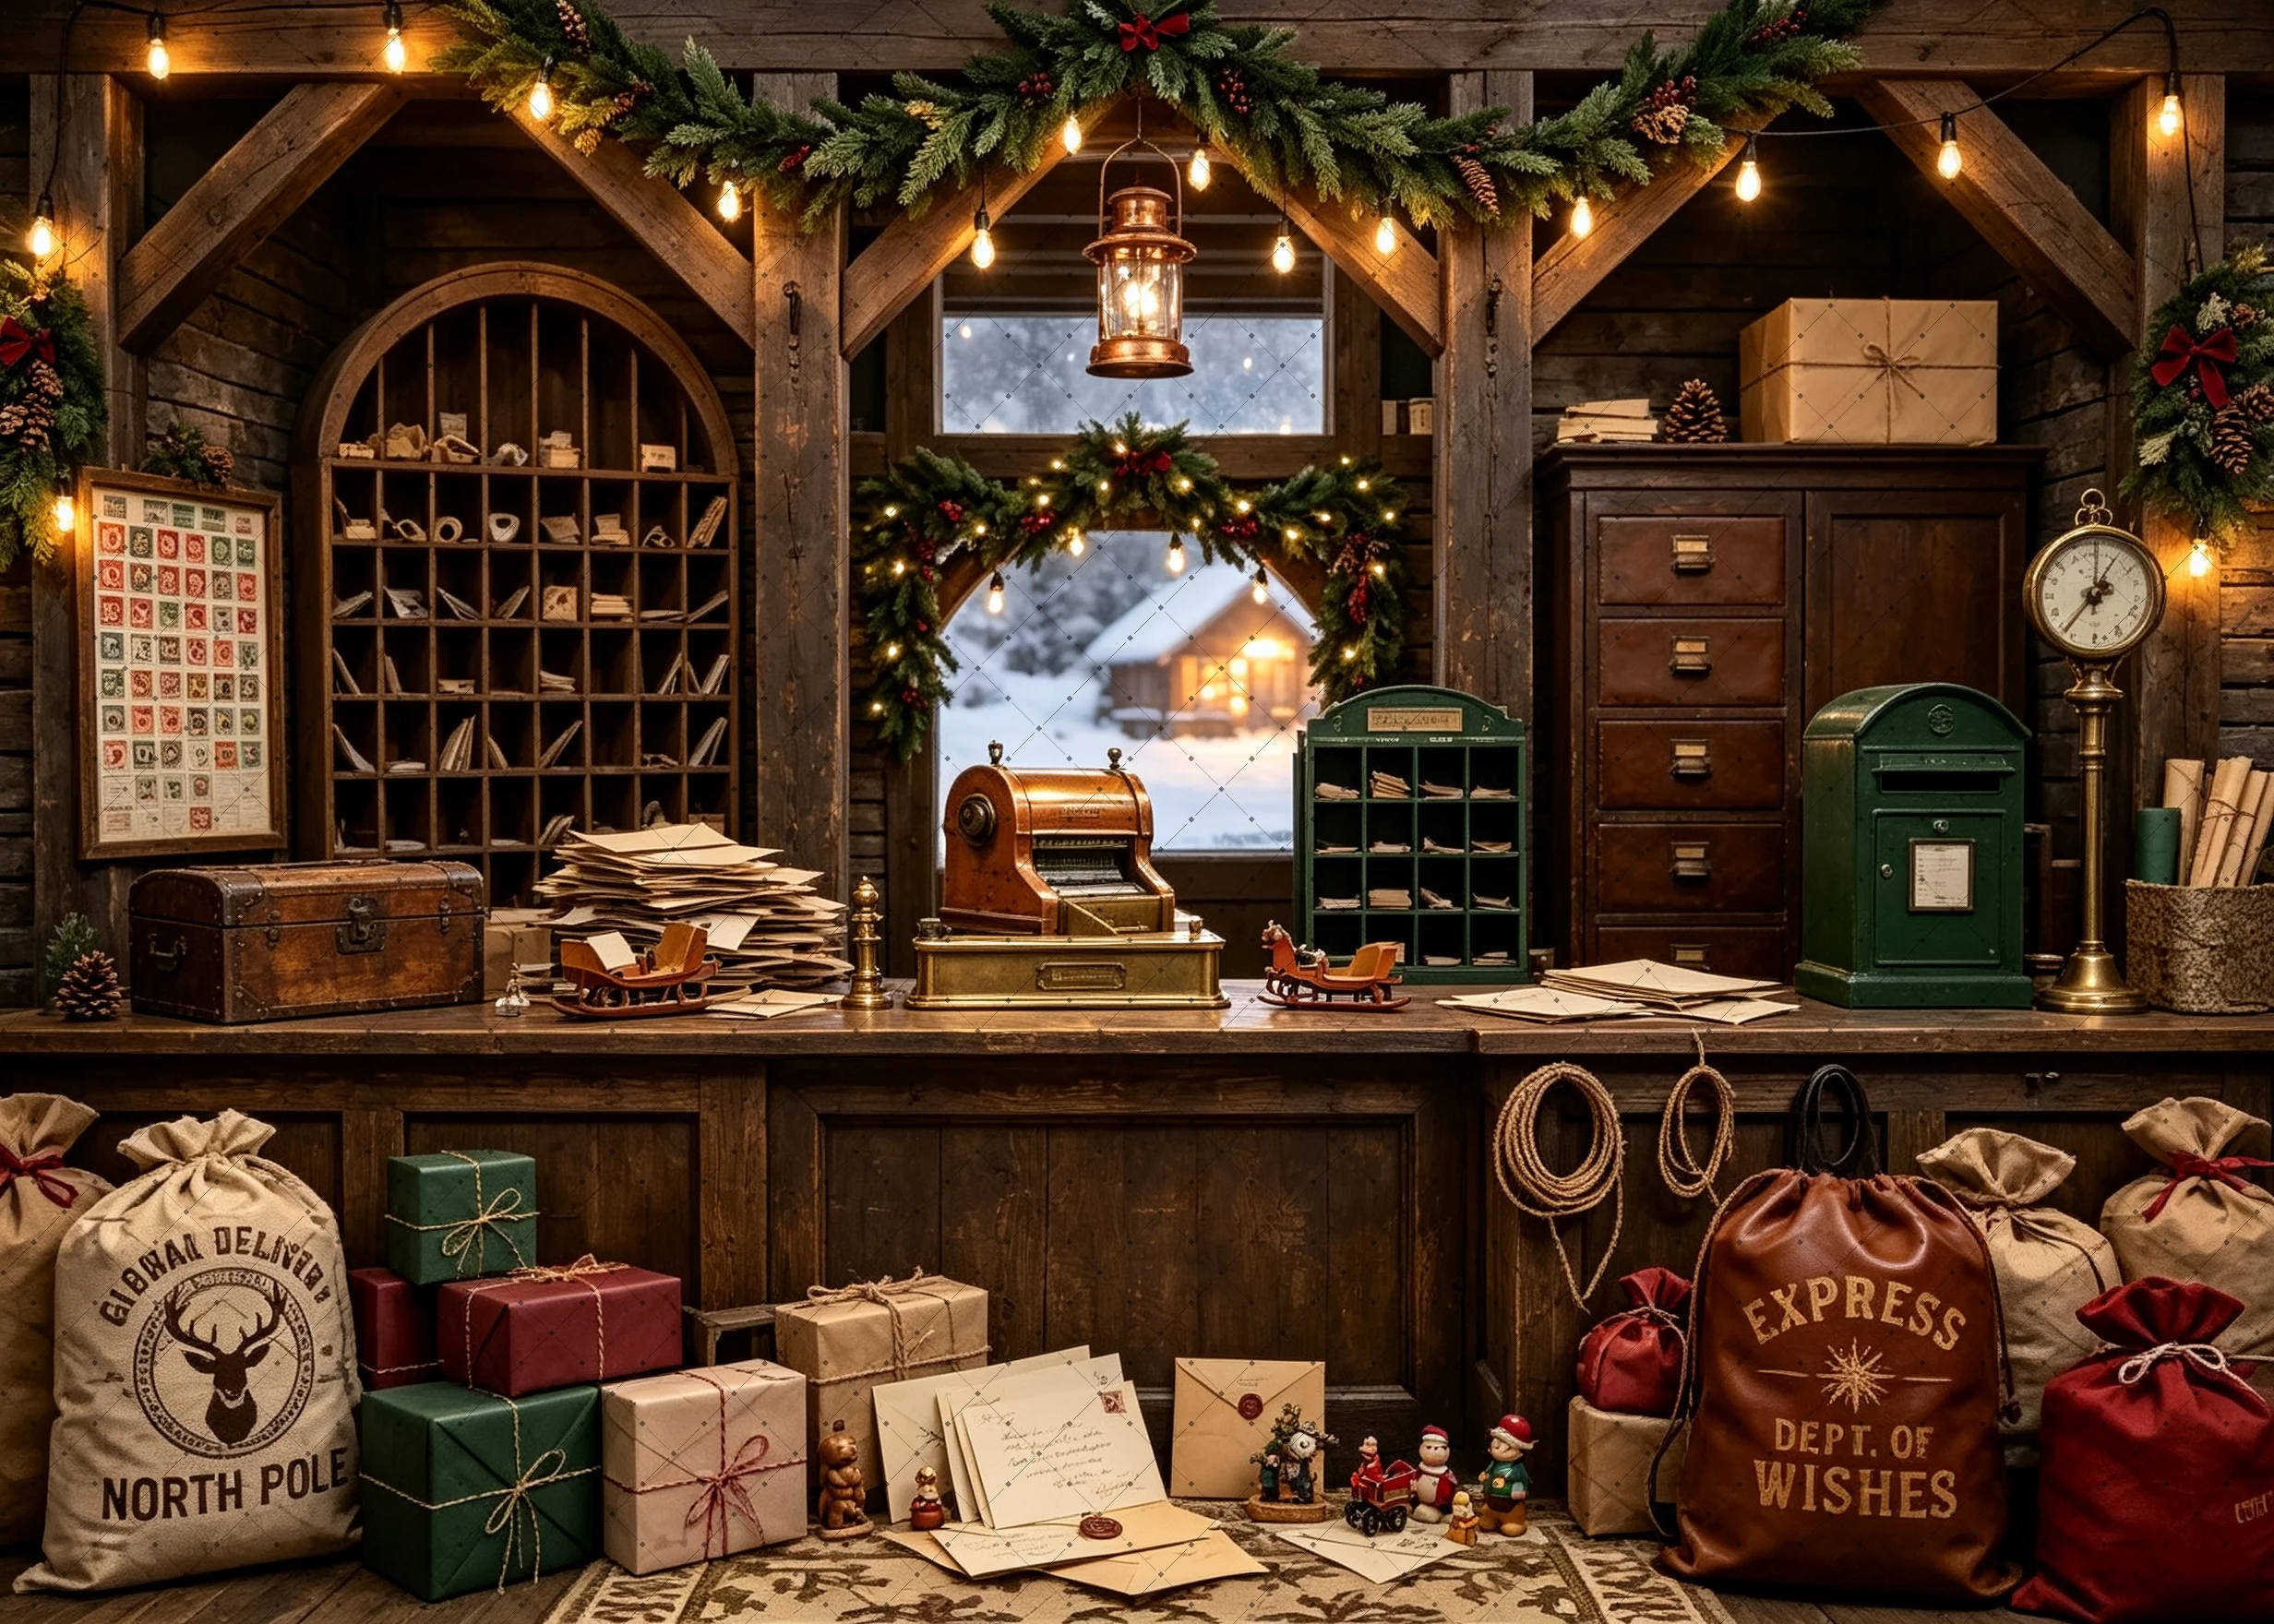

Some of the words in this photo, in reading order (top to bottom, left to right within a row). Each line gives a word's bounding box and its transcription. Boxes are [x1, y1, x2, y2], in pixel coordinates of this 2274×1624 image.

[1742, 1274, 1967, 1351] EXPRESS
[1775, 1417, 1877, 1458] DEPT.
[1890, 1424, 1934, 1460] OF
[102, 1468, 245, 1522] NORTH
[260, 1446, 350, 1506] POLE
[1753, 1458, 1958, 1520] WISHES
